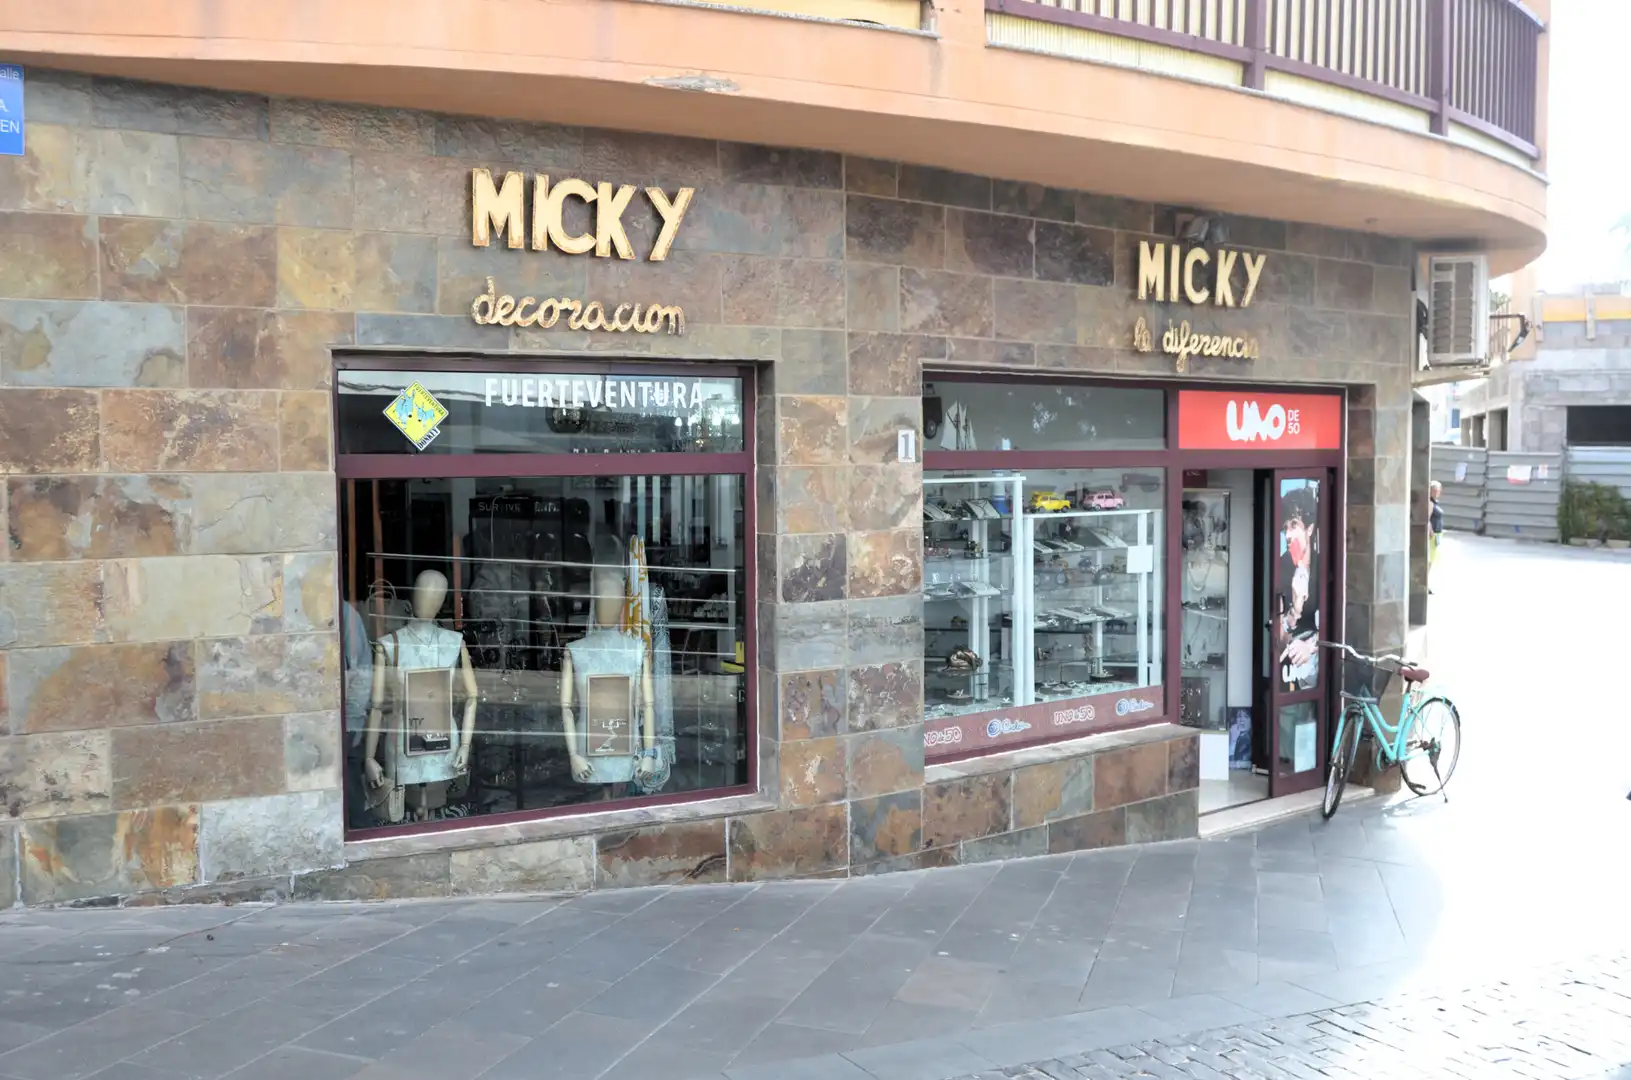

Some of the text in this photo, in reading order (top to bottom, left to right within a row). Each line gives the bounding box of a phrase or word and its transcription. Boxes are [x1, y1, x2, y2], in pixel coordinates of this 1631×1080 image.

[0, 67, 19, 81] alle
[0, 119, 20, 134] EN
[472, 167, 696, 261] MICKY
[1138, 240, 1267, 307] MICKY
[471, 275, 686, 336] decoracion
[484, 377, 703, 409] FUERTEVENTURA
[1226, 400, 1300, 442] UNO DE
[1288, 422, 1300, 435] 50
[901, 433, 913, 460] 1
